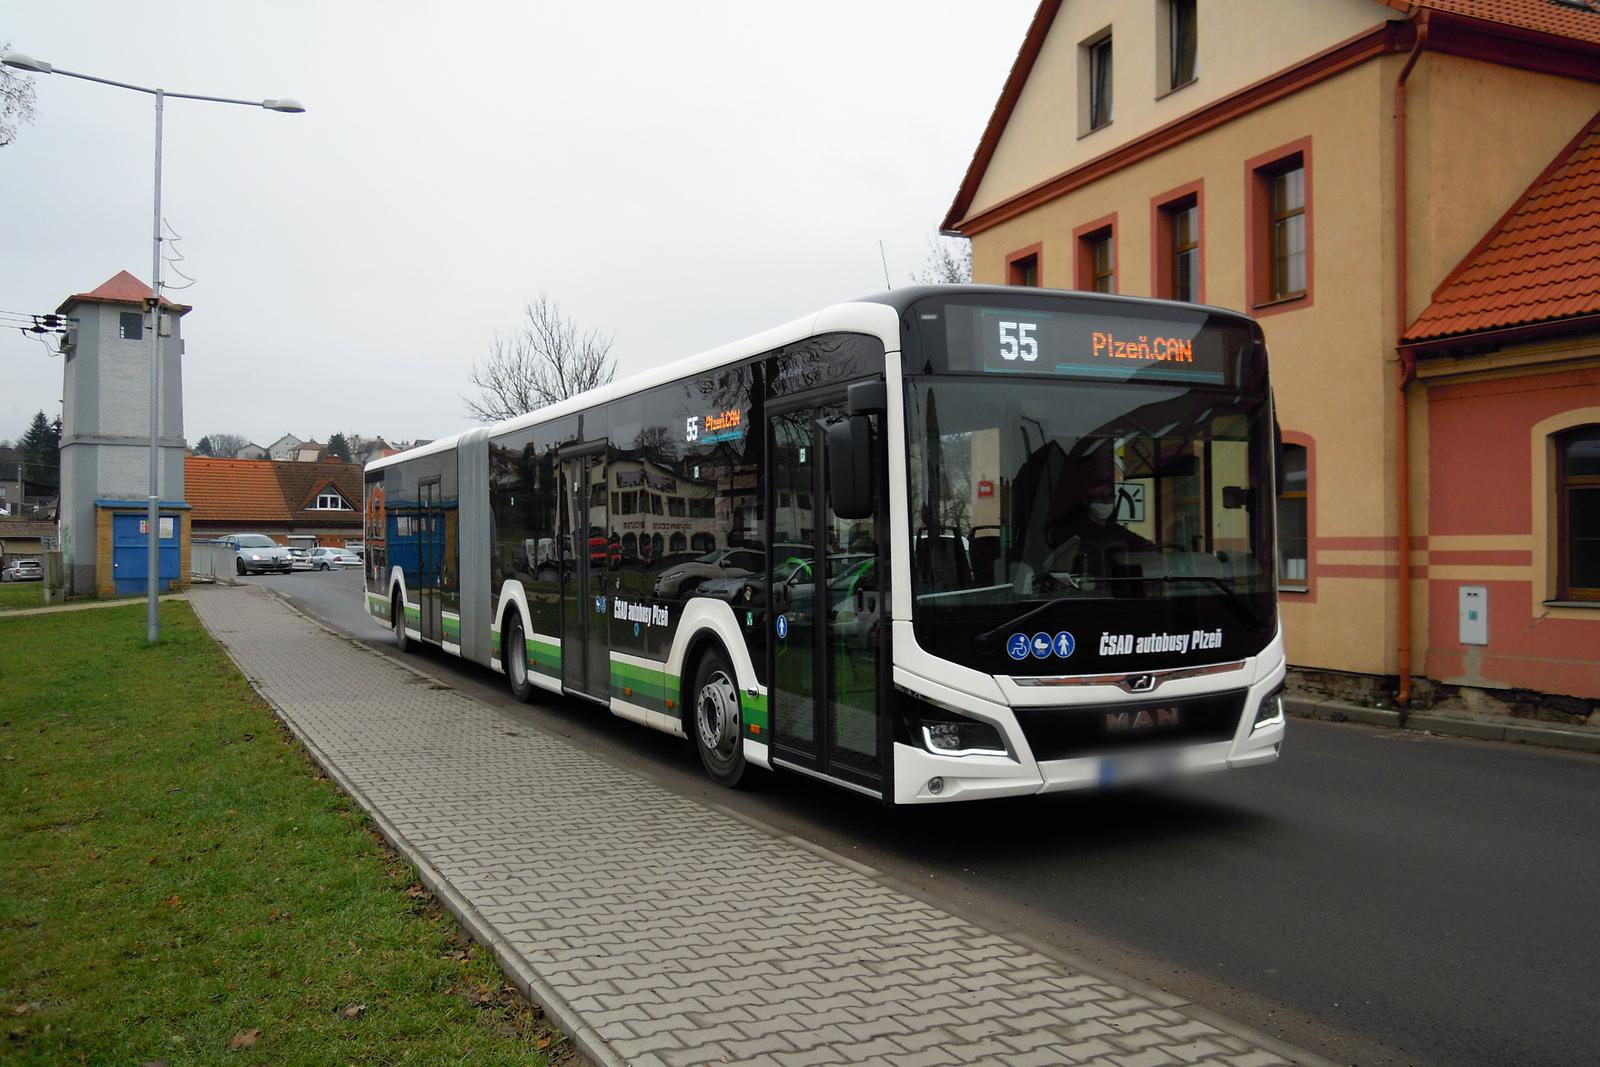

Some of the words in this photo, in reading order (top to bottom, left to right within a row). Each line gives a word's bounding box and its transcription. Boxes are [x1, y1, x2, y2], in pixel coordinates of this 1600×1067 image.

[999, 322, 1038, 361] 55
[1091, 332, 1193, 363] Plzeň.CAN
[686, 416, 698, 442] 55
[614, 597, 628, 620] ČSAD
[628, 602, 652, 627] autobusy
[652, 605, 669, 627] Plzeň
[1099, 631, 1134, 656] ČSAD
[1136, 632, 1190, 655] autobusy
[1191, 628, 1222, 651] Plzeň
[1105, 707, 1180, 731] MAN
